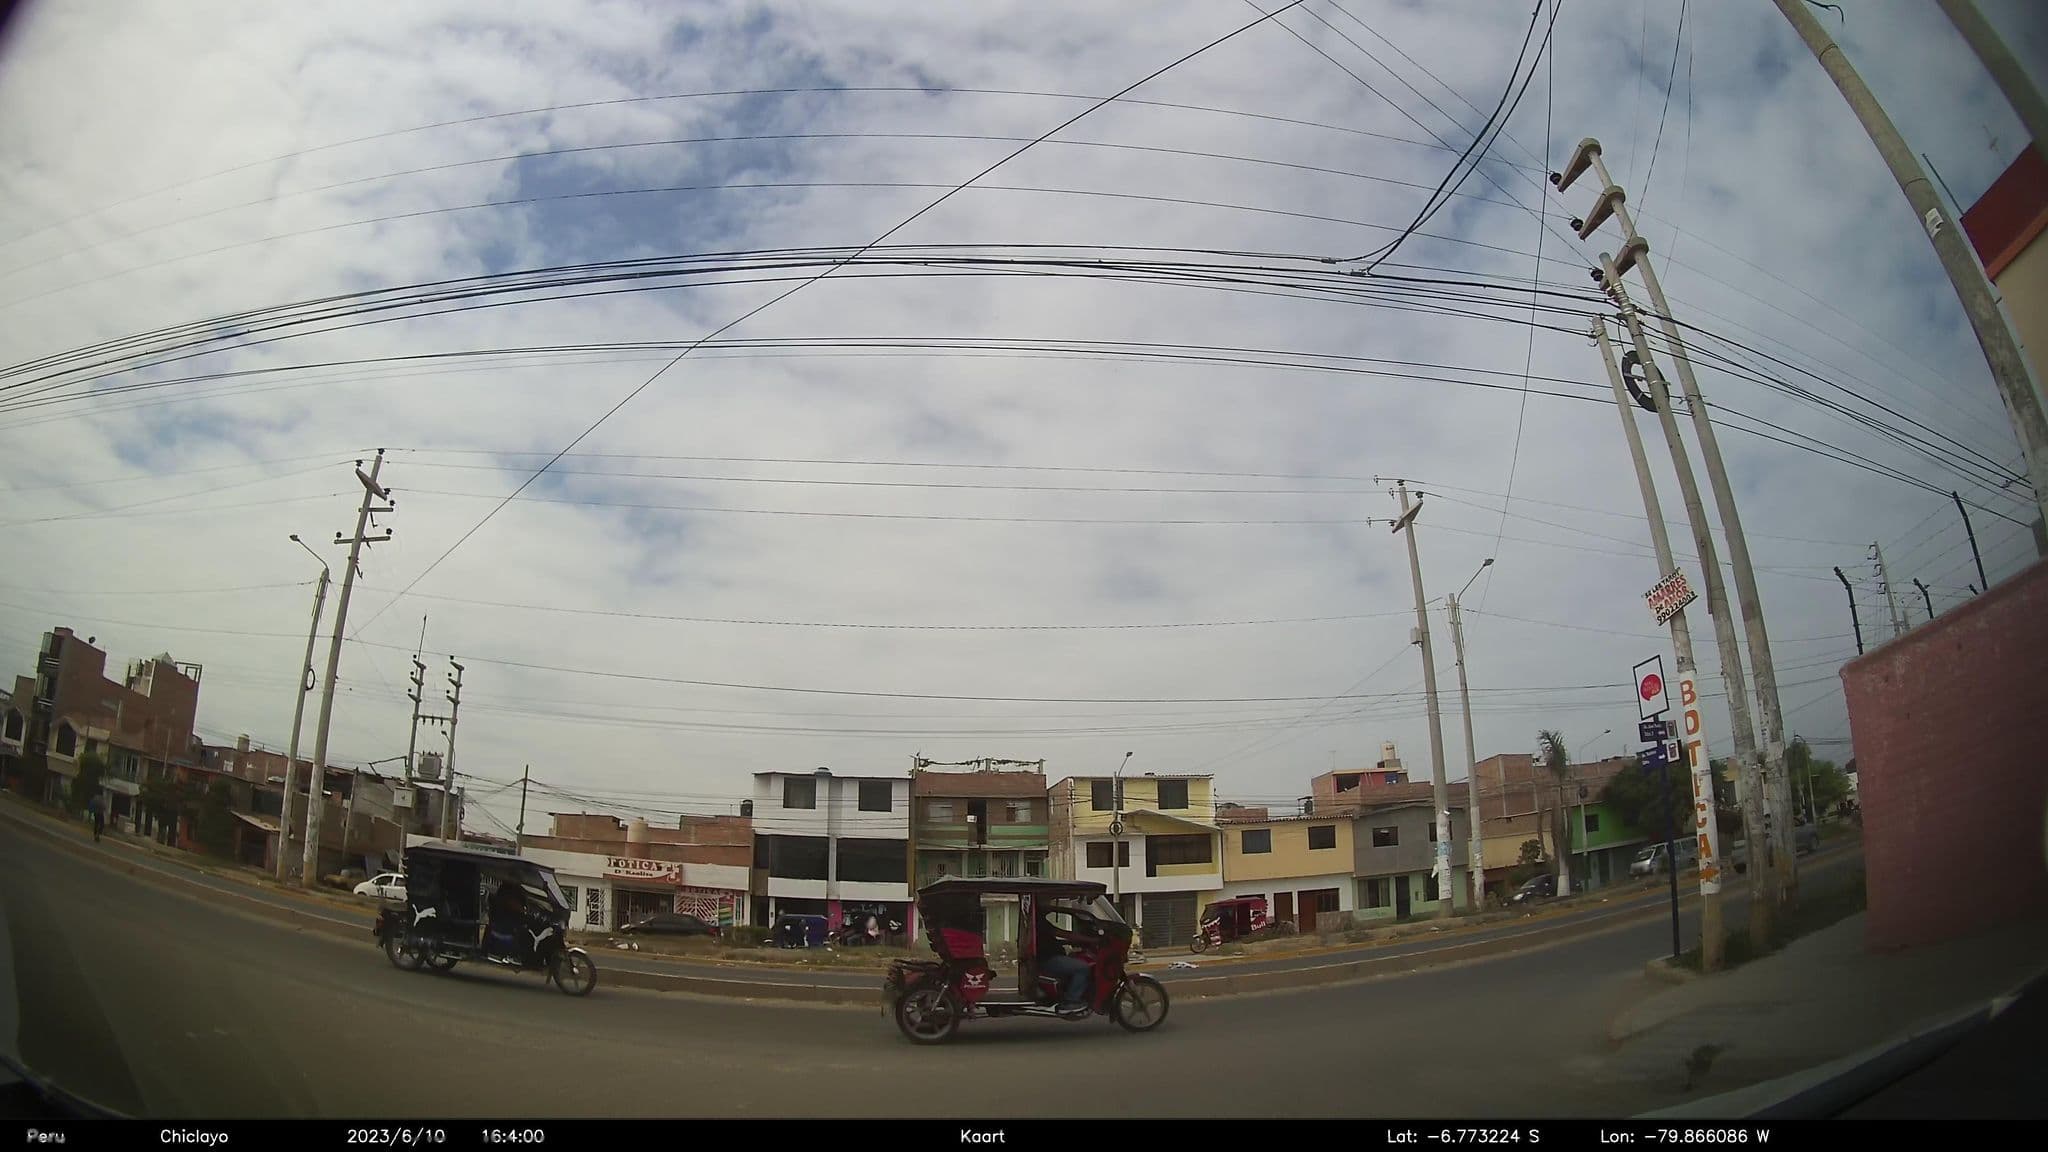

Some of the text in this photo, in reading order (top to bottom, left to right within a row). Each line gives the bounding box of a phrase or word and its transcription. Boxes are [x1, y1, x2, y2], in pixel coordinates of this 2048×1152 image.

[1648, 574, 1686, 608] AMARRES
[1655, 586, 1689, 614] DE AMOR
